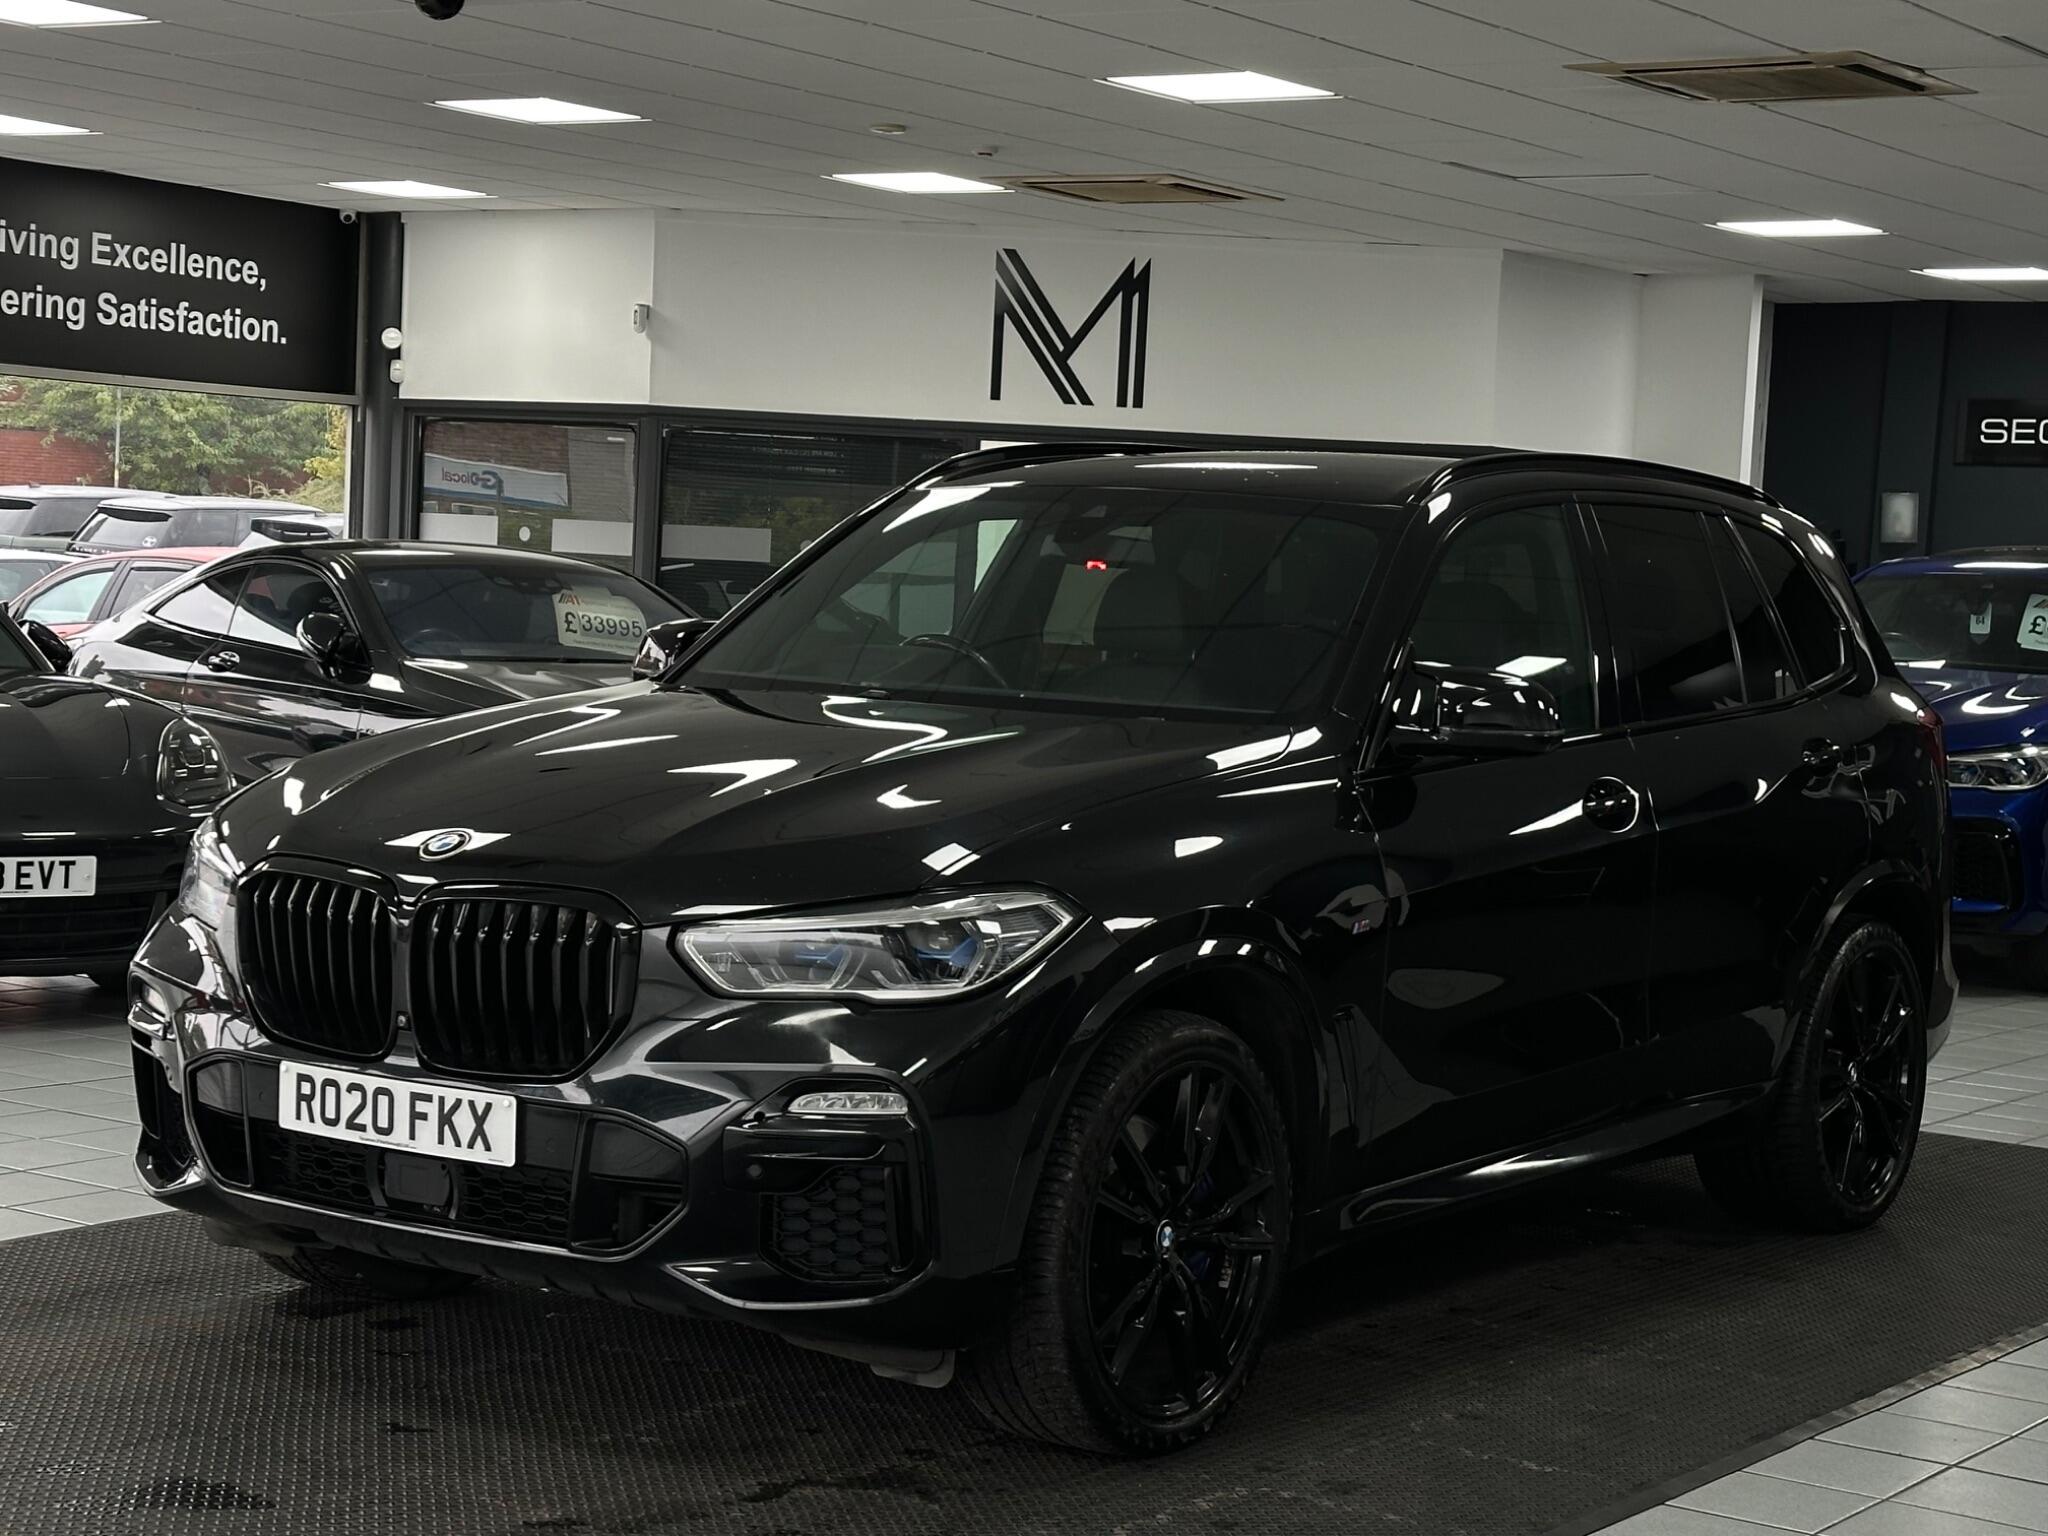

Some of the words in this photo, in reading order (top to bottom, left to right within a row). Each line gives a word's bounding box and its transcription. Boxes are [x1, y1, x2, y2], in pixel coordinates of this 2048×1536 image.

[91, 231, 267, 292] Excellence,
[0, 284, 86, 331] ering
[96, 291, 287, 345] Satisfaction.
[564, 611, 643, 638] £33995
[15, 860, 77, 890] EVT
[408, 1091, 493, 1153] FKX
